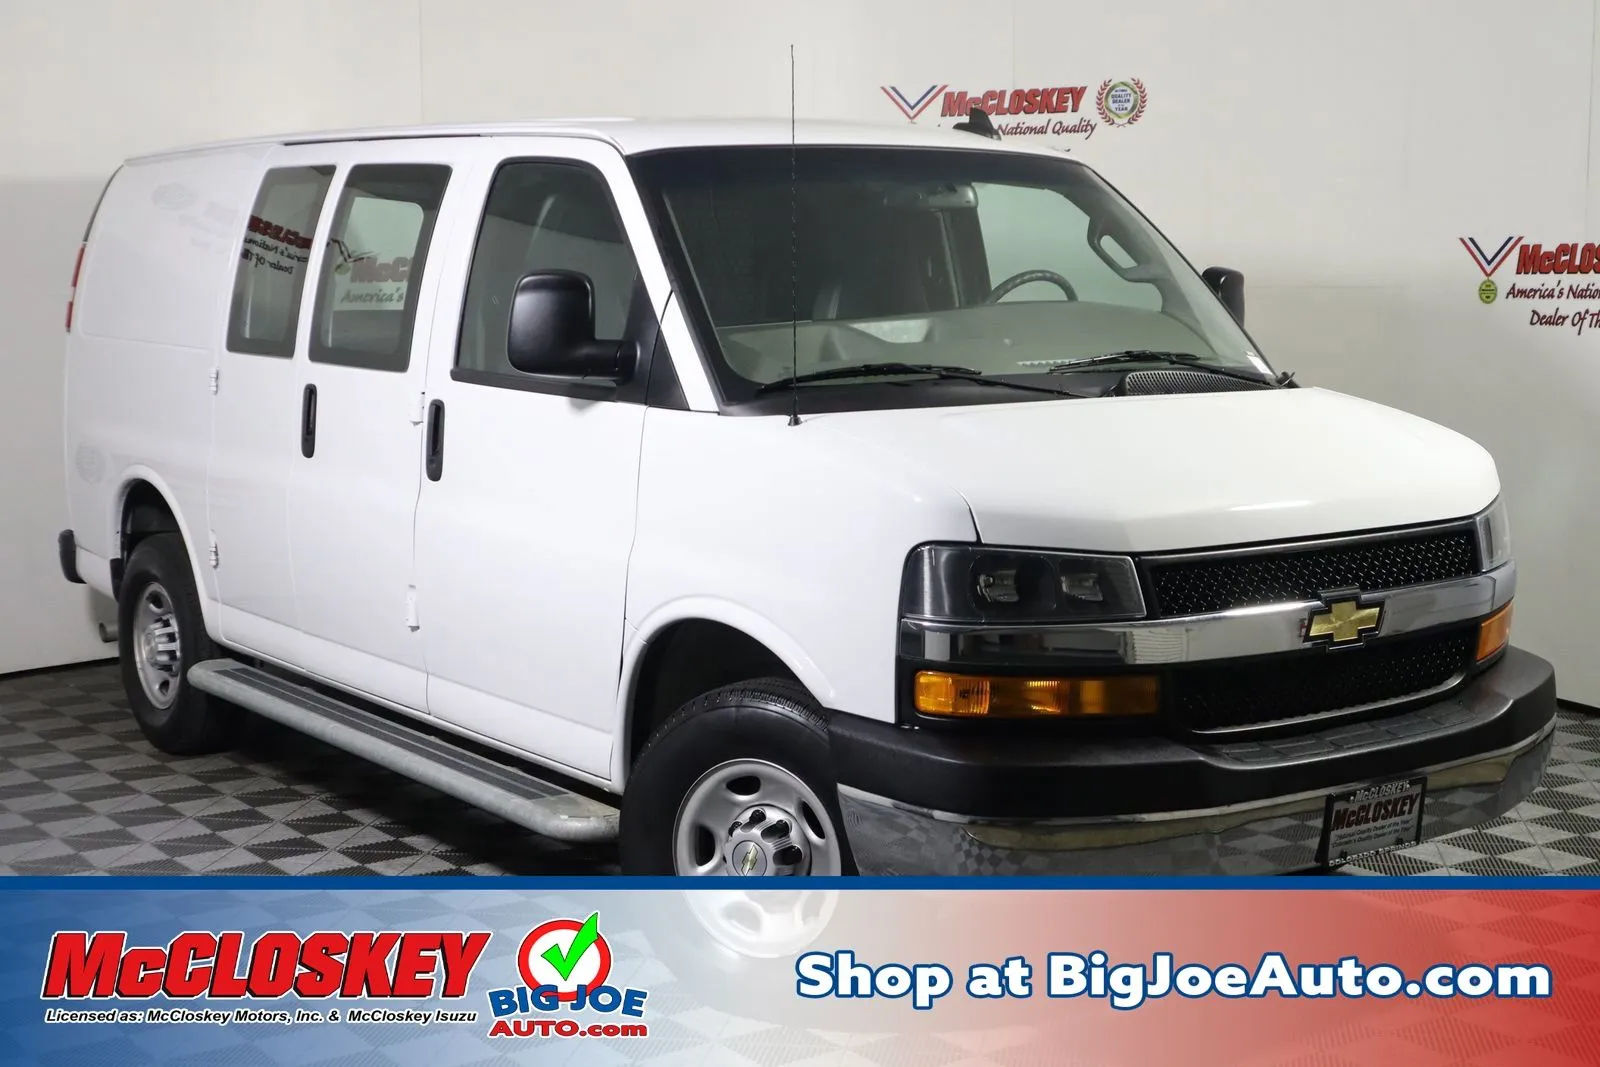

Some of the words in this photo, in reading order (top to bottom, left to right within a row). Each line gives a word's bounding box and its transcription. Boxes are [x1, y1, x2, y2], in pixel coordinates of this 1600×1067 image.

[1052, 117, 1097, 140] Quality
[1506, 280, 1564, 299] America's
[1567, 282, 1600, 299] Natio
[1529, 307, 1569, 326] Dealer
[1571, 308, 1589, 336] Of
[1331, 793, 1420, 831] McCLOSKEY
